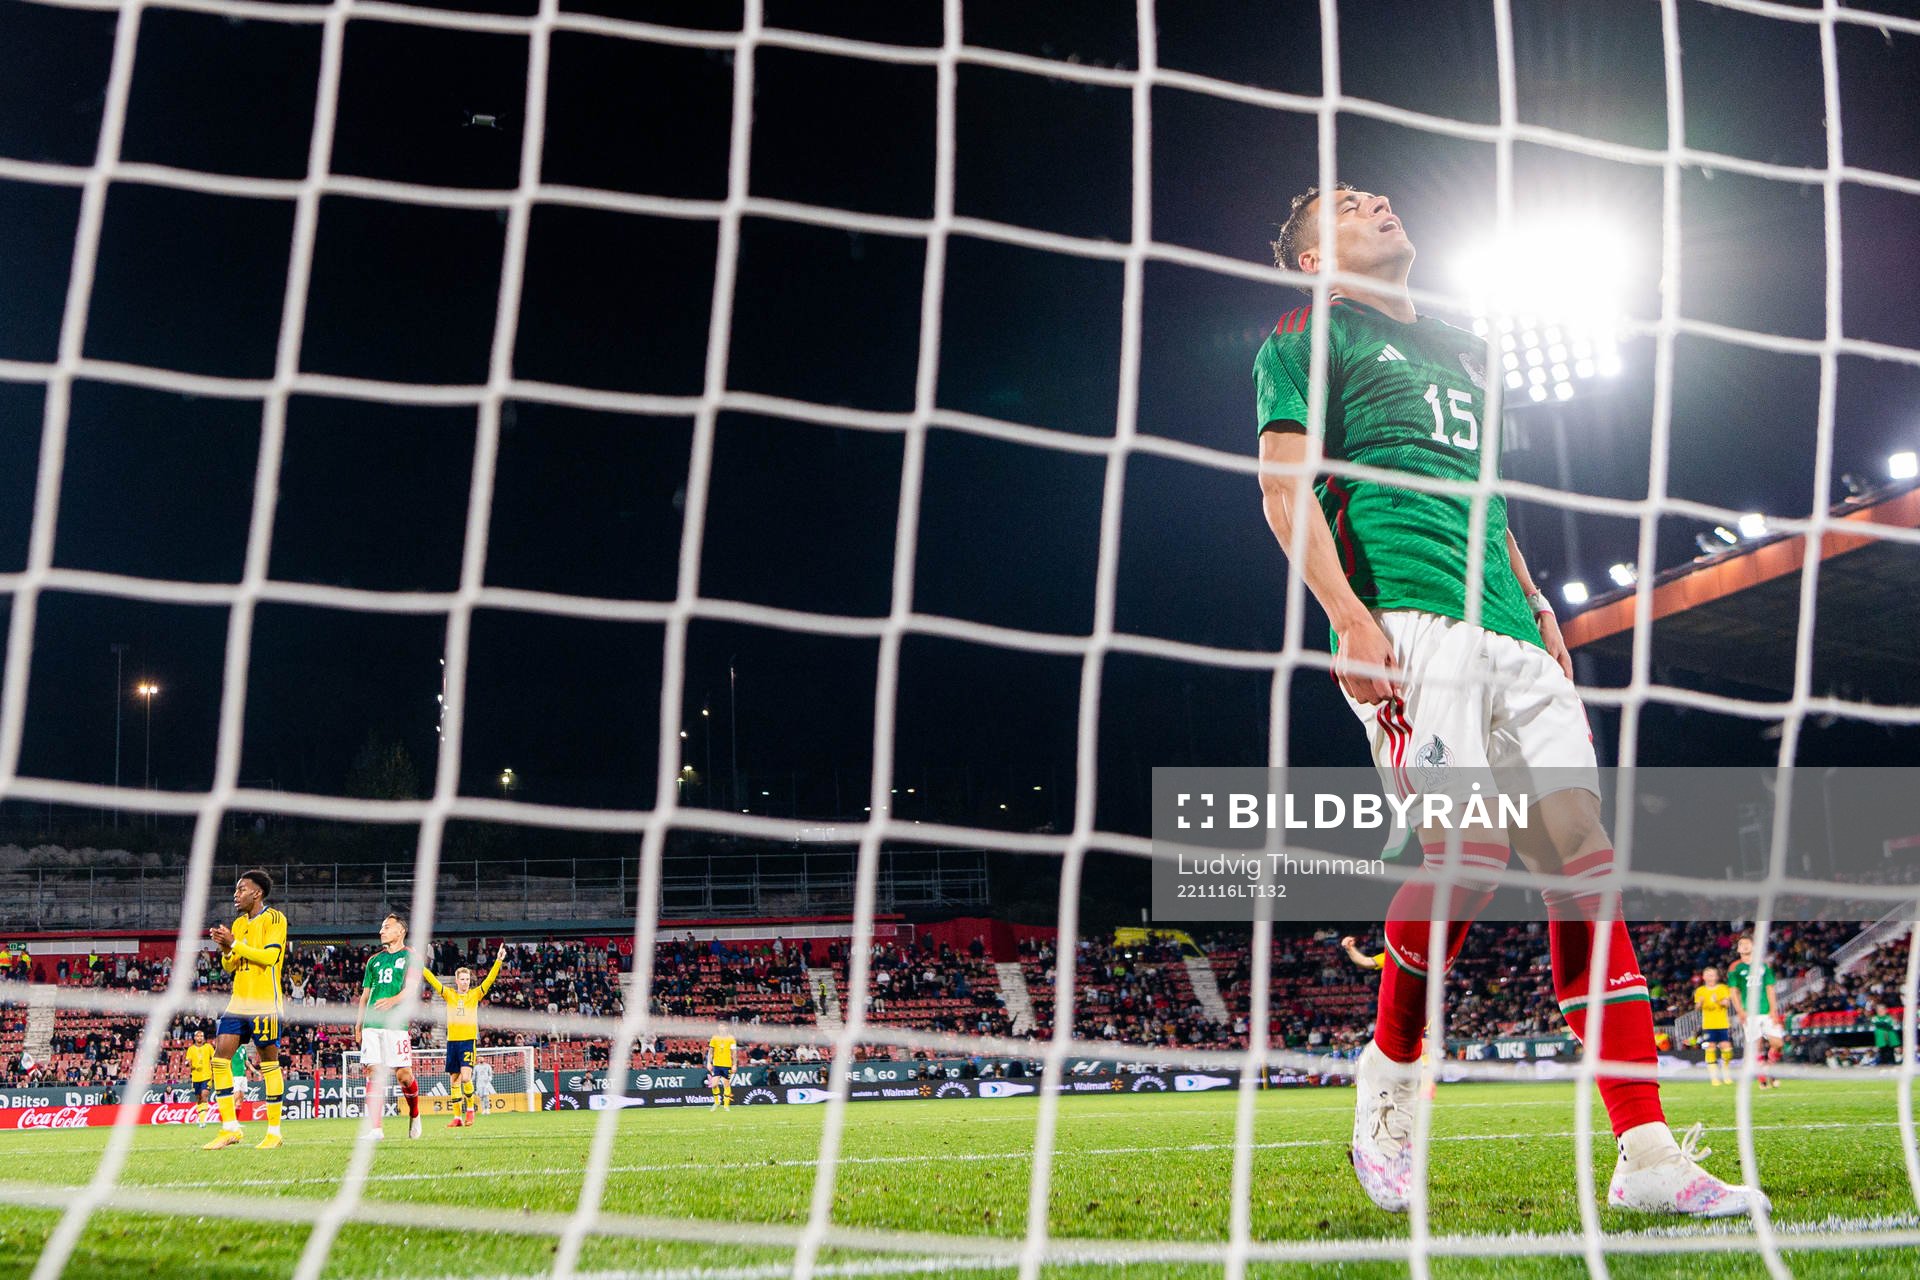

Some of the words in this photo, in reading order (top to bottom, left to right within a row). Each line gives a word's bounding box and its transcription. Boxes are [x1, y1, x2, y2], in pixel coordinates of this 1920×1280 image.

[1423, 383, 1478, 450] 15
[378, 967, 393, 984] 18
[253, 1015, 270, 1034] 11
[396, 1040, 410, 1056] 18
[878, 1070, 897, 1080] GO
[654, 1076, 685, 1088] AT&T
[1074, 1081, 1111, 1091] Walmart
[881, 1087, 919, 1097] Walmart
[12, 1095, 49, 1108] Bitso
[685, 1094, 722, 1104] Walmat
[17, 1106, 91, 1129] Coca-Cola
